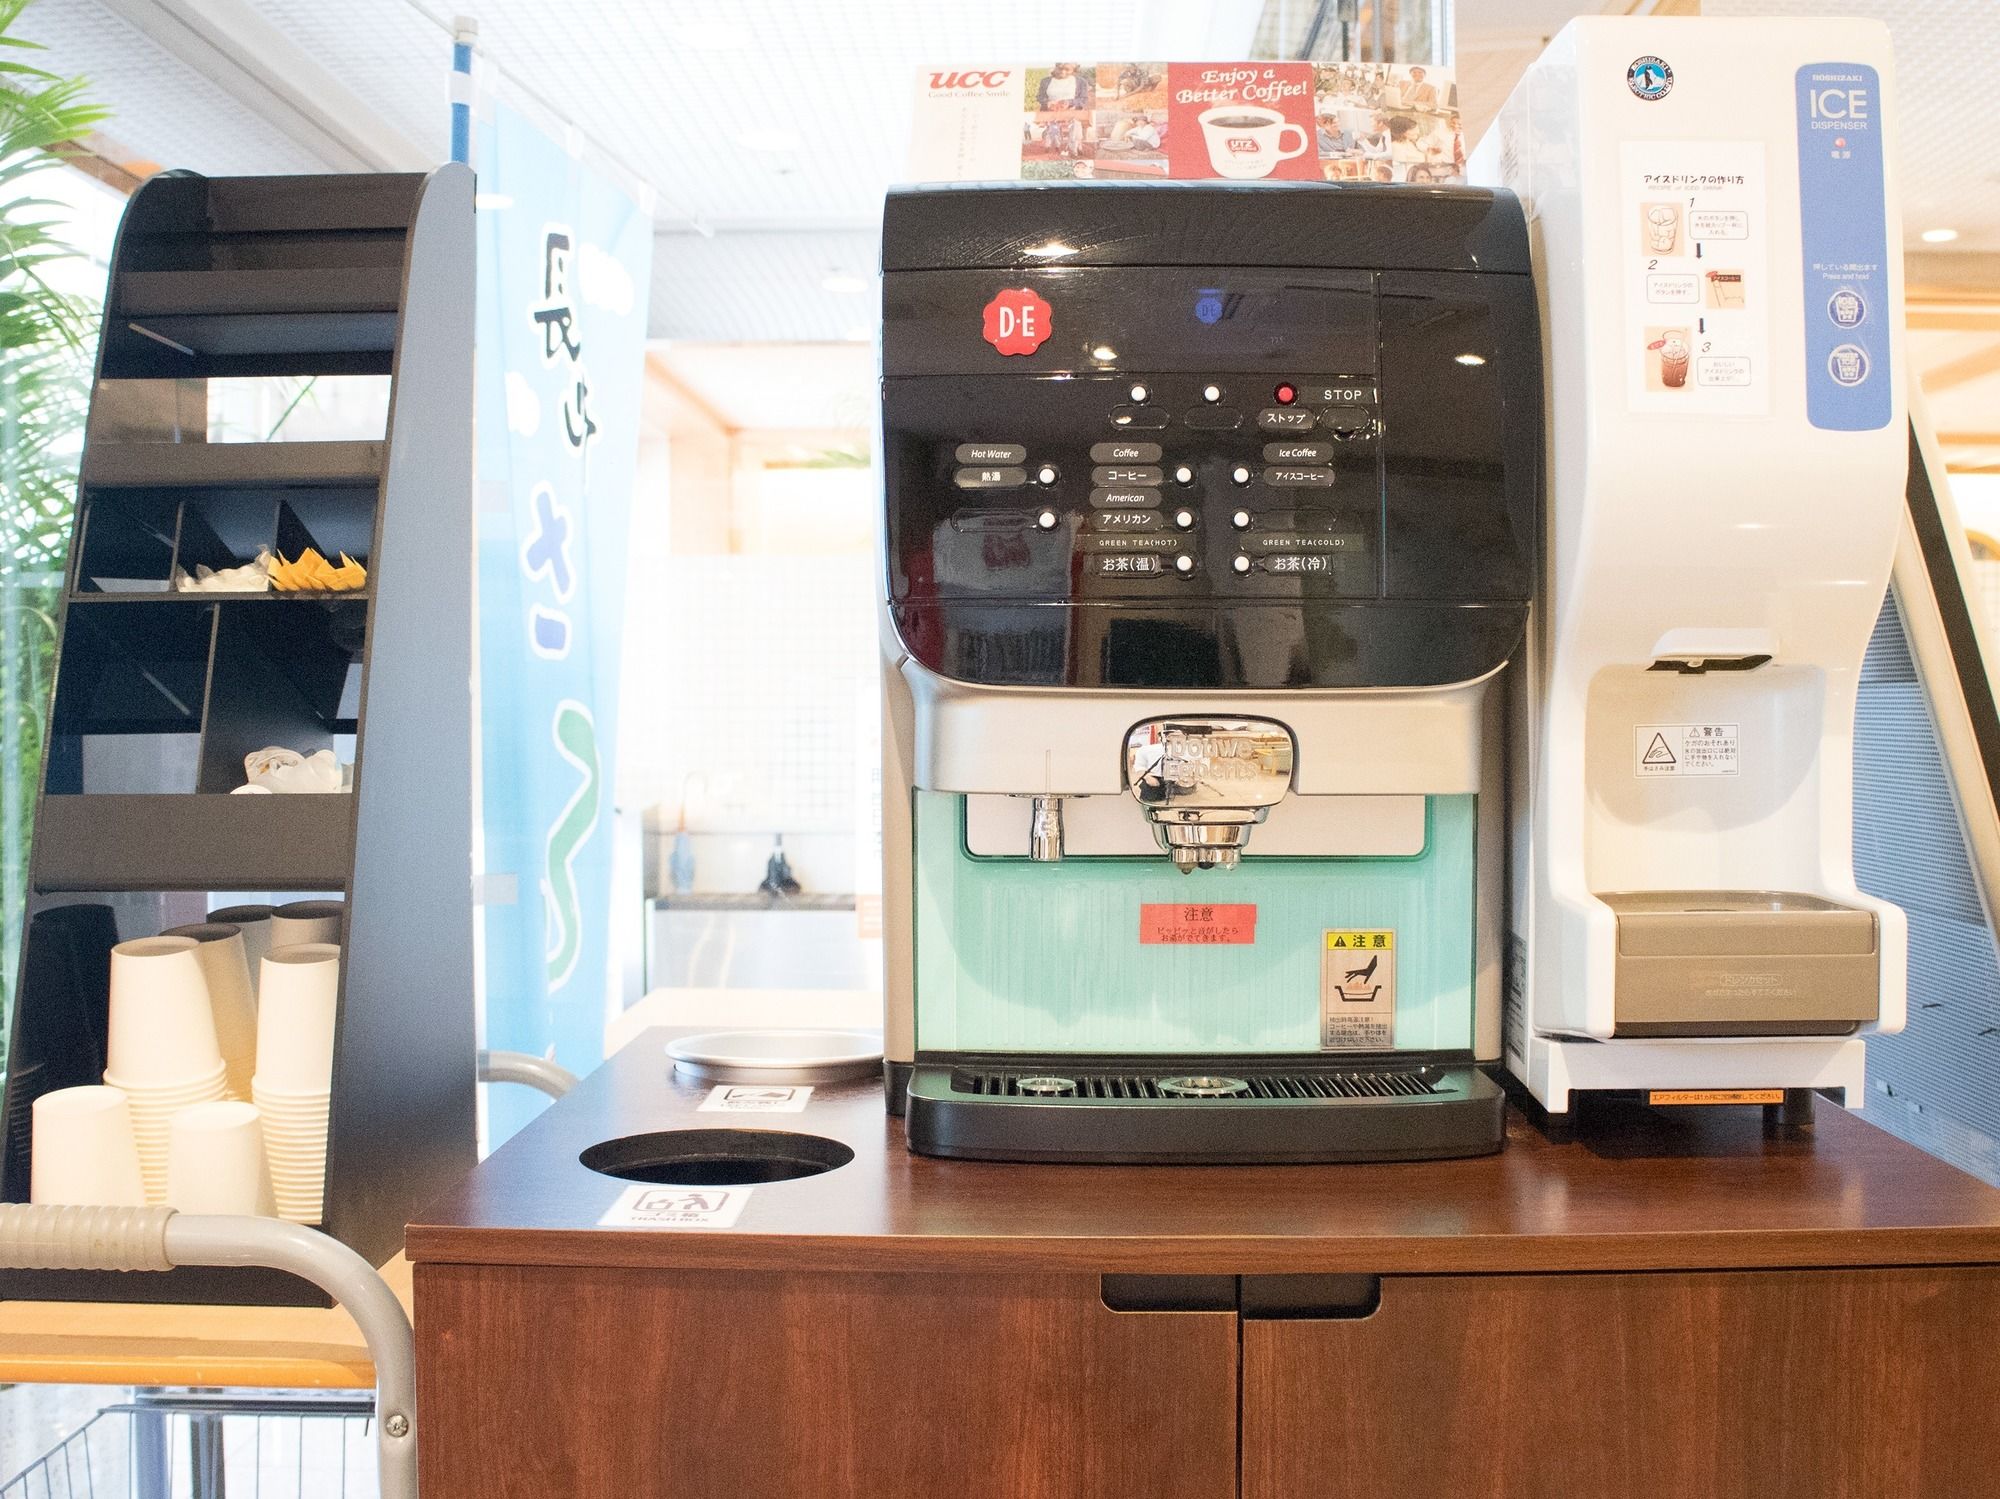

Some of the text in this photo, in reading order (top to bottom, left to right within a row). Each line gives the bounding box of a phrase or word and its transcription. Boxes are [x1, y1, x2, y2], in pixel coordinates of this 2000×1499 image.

[1202, 68, 1275, 85] Enjoy a
[1812, 74, 1862, 82] HOSHIZAKI
[1176, 80, 1307, 104] Better Coffee!
[1810, 88, 1867, 119] ICE
[1811, 121, 1868, 130] DISPENSER
[1230, 140, 1253, 148] UTZ
[1643, 174, 1745, 185] アイスドリンクの作り方
[1689, 197, 1695, 208] 1
[1648, 259, 1658, 270] 2
[1701, 341, 1712, 353] 3
[1324, 389, 1362, 400] STOP
[1267, 413, 1306, 424] ストップ
[971, 449, 1012, 459] Hot Water
[1113, 448, 1139, 457] Coffee
[1279, 448, 1317, 457] Ice Coffee
[1108, 471, 1147, 480] コーヒー
[1275, 472, 1324, 480] アイスコーヒー
[1106, 493, 1145, 503] American
[1102, 514, 1151, 524] アメリカン
[1133, 539, 1177, 547] TEA(HOT)
[1296, 539, 1345, 547] TEA(COLD)
[1704, 727, 1725, 737] 警告
[1166, 734, 1253, 758] Douwe
[1163, 760, 1257, 787] Egberts
[1184, 907, 1214, 922] 注意
[1353, 934, 1386, 948] 注意
